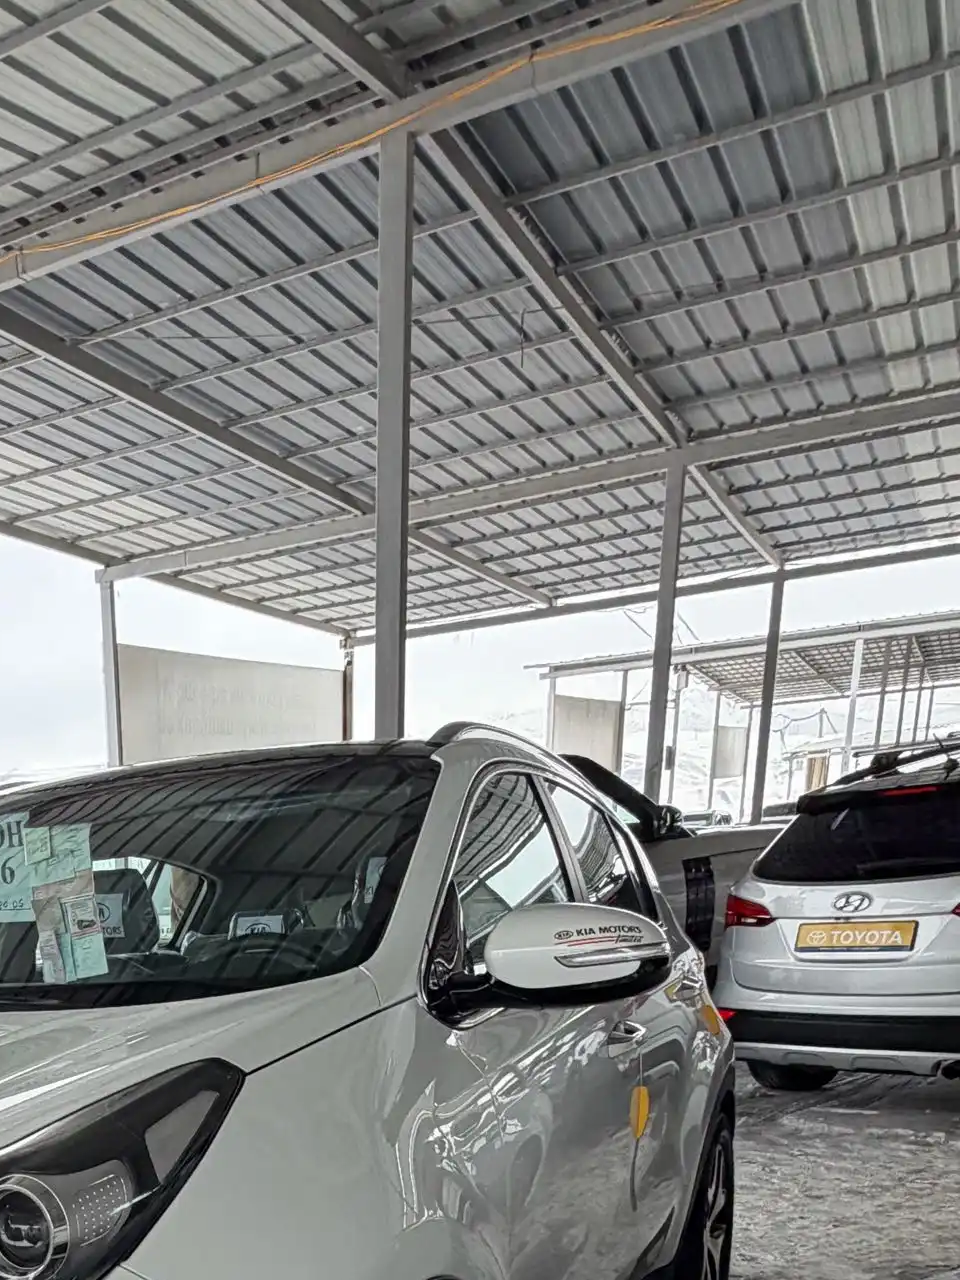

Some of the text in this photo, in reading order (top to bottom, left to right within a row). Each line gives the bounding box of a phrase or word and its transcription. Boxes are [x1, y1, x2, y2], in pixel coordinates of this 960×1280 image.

[103, 926, 122, 936] TORS
[575, 927, 596, 937] KIA
[598, 925, 642, 934] MOTORS
[831, 929, 903, 945] TOYOTA
